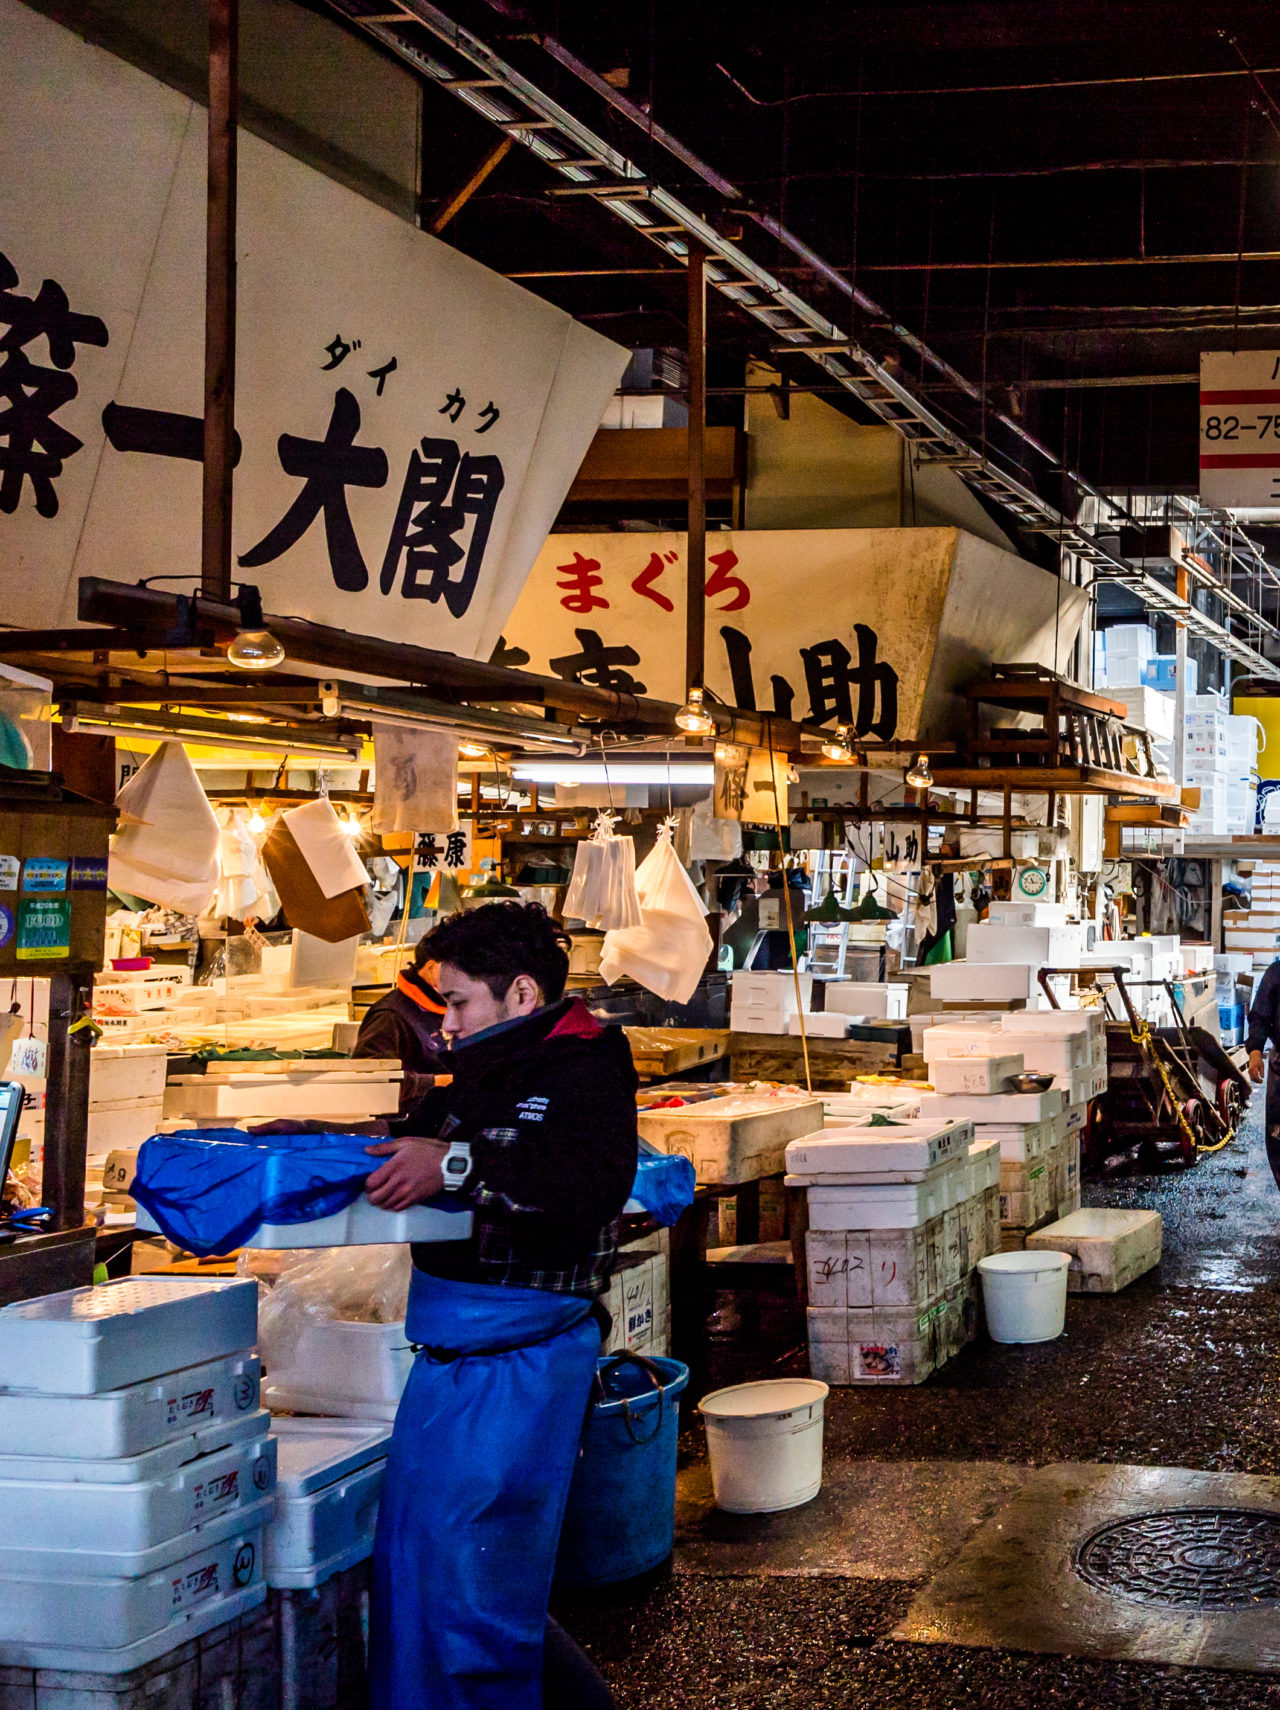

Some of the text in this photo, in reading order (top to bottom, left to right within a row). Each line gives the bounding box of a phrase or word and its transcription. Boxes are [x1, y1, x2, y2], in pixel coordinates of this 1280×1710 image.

[556, 550, 752, 613] まぐろ
[886, 829, 918, 863] 山助
[518, 1111, 544, 1122] ATMOS
